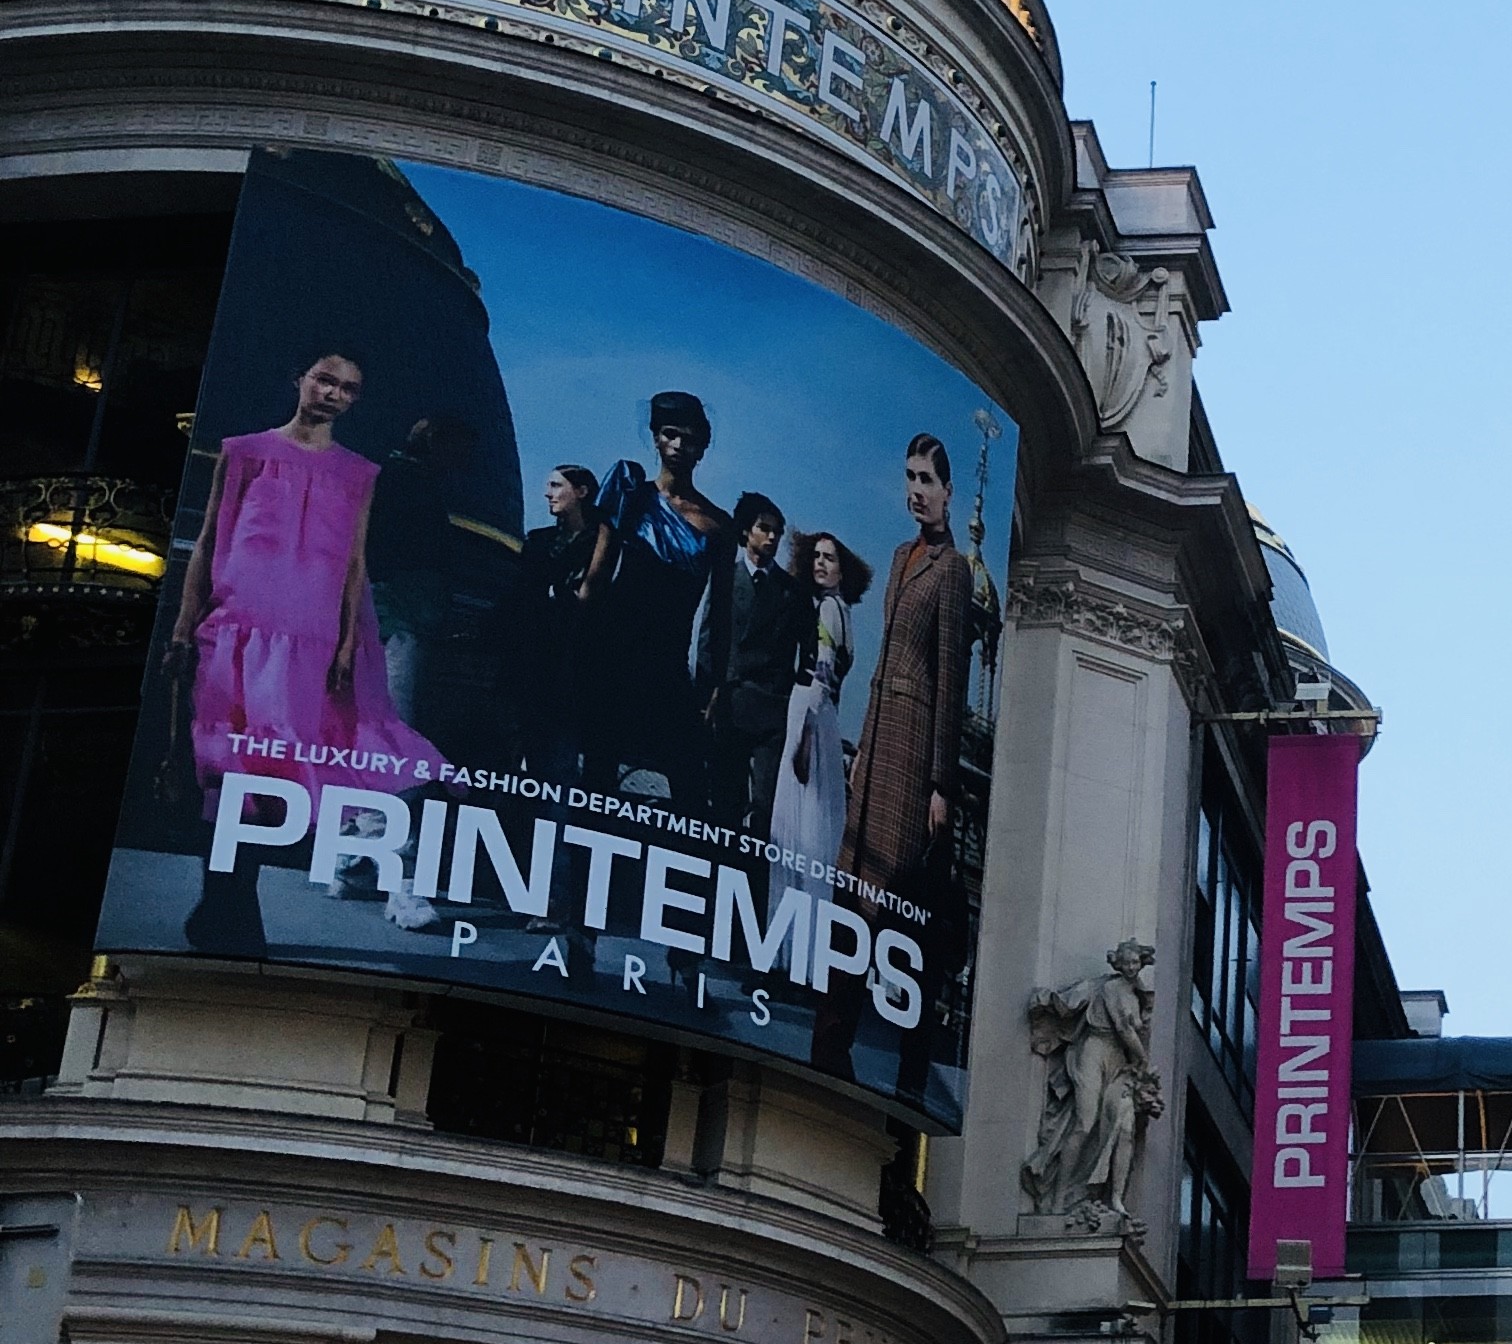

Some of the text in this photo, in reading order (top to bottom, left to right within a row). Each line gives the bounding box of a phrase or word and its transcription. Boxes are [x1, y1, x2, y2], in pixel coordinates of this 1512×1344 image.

[227, 733, 287, 759] THE
[294, 742, 408, 775] LUXURY
[413, 759, 432, 780] &
[439, 763, 562, 802] FASHION
[568, 787, 736, 848] DEPARTMENT
[739, 830, 807, 874] STORE
[208, 771, 924, 1029] PRINTEMPS
[450, 920, 771, 1026] PARIS
[1273, 818, 1338, 1189] PRINTEMPS
[166, 1203, 598, 1302] MAGASINS
[669, 1273, 750, 1332] DU
